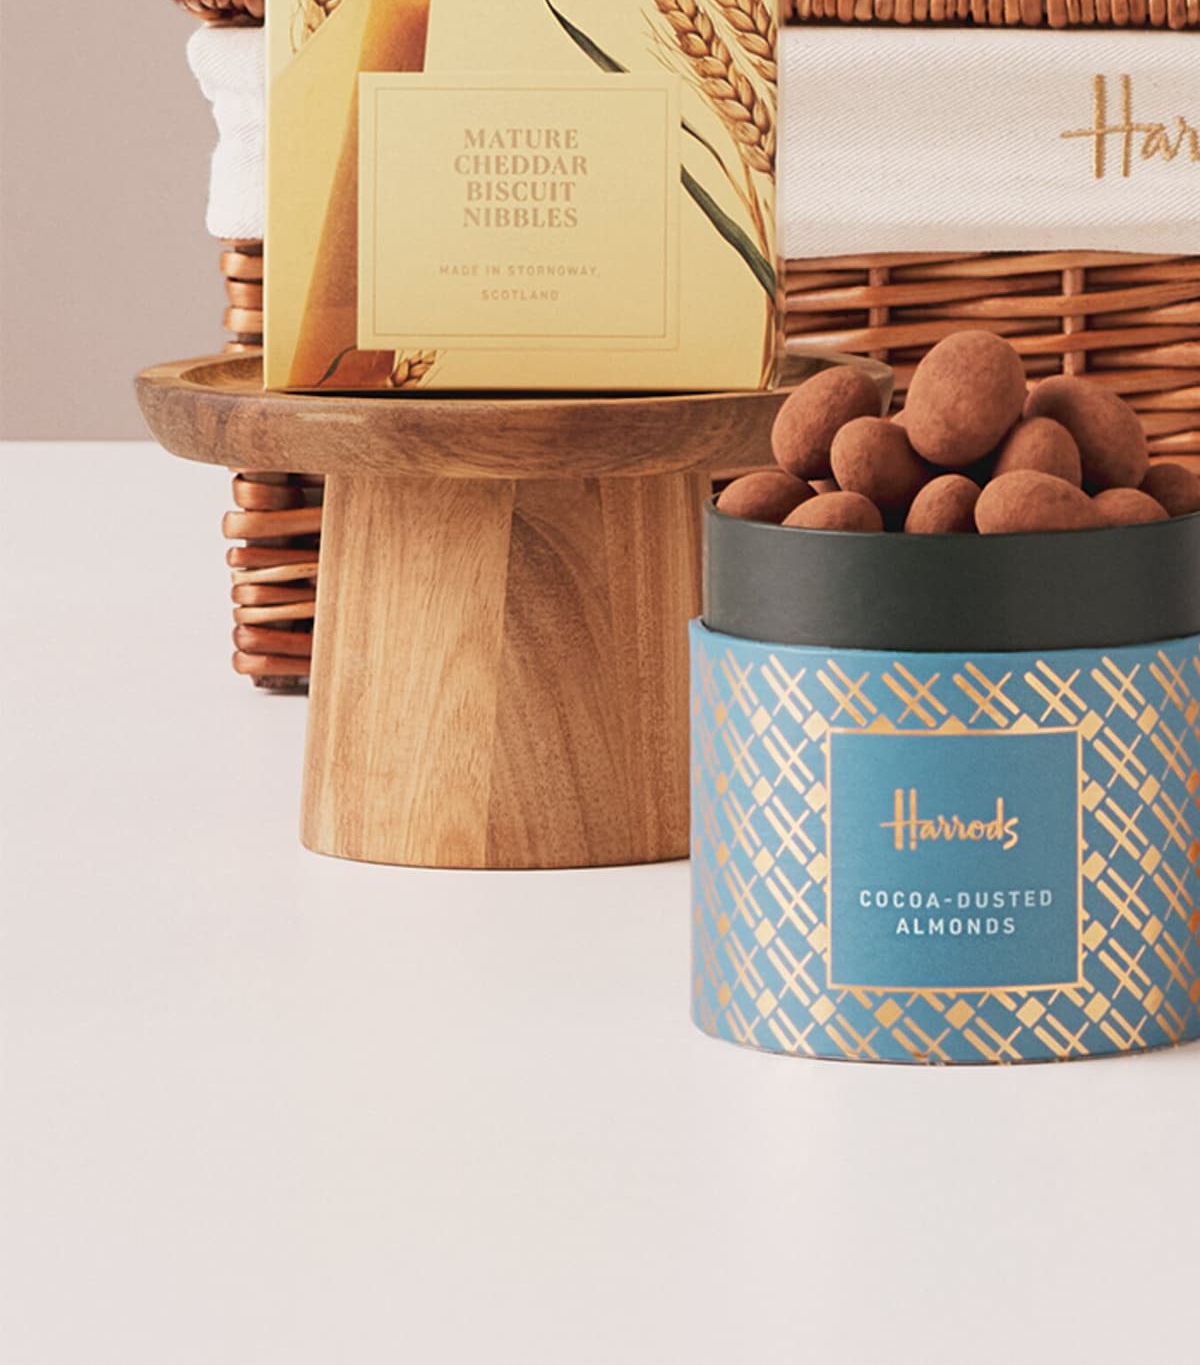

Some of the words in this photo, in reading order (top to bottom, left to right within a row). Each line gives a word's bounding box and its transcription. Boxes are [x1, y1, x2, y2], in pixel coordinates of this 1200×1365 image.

[463, 128, 579, 149] MATURE
[453, 154, 588, 175] CHEDDAR
[466, 180, 577, 202] BISCUIT
[463, 207, 579, 228] NIBBLES
[439, 265, 480, 276] MADE
[486, 265, 500, 276] IN
[481, 289, 559, 301] SCOTLAND
[880, 788, 1020, 851] Harrods
[859, 889, 1053, 909] COCOA-DUSTED
[896, 917, 1016, 935] ALMONDS
